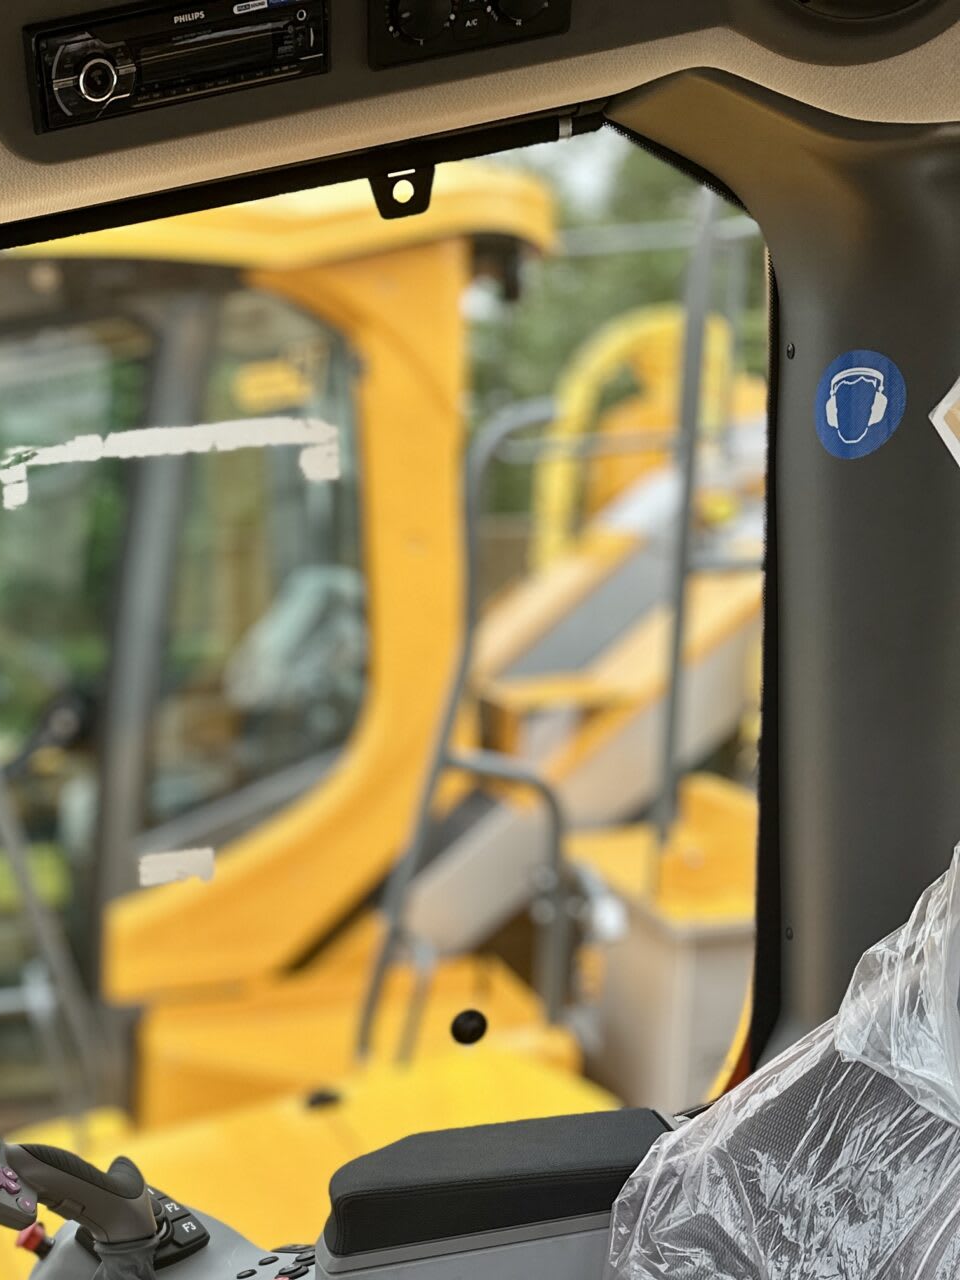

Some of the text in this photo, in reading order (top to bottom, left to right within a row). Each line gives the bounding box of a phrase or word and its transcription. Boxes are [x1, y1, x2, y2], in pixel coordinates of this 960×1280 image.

[173, 10, 206, 24] PHILIPS
[164, 1202, 180, 1213] F2
[181, 1221, 197, 1233] F3
